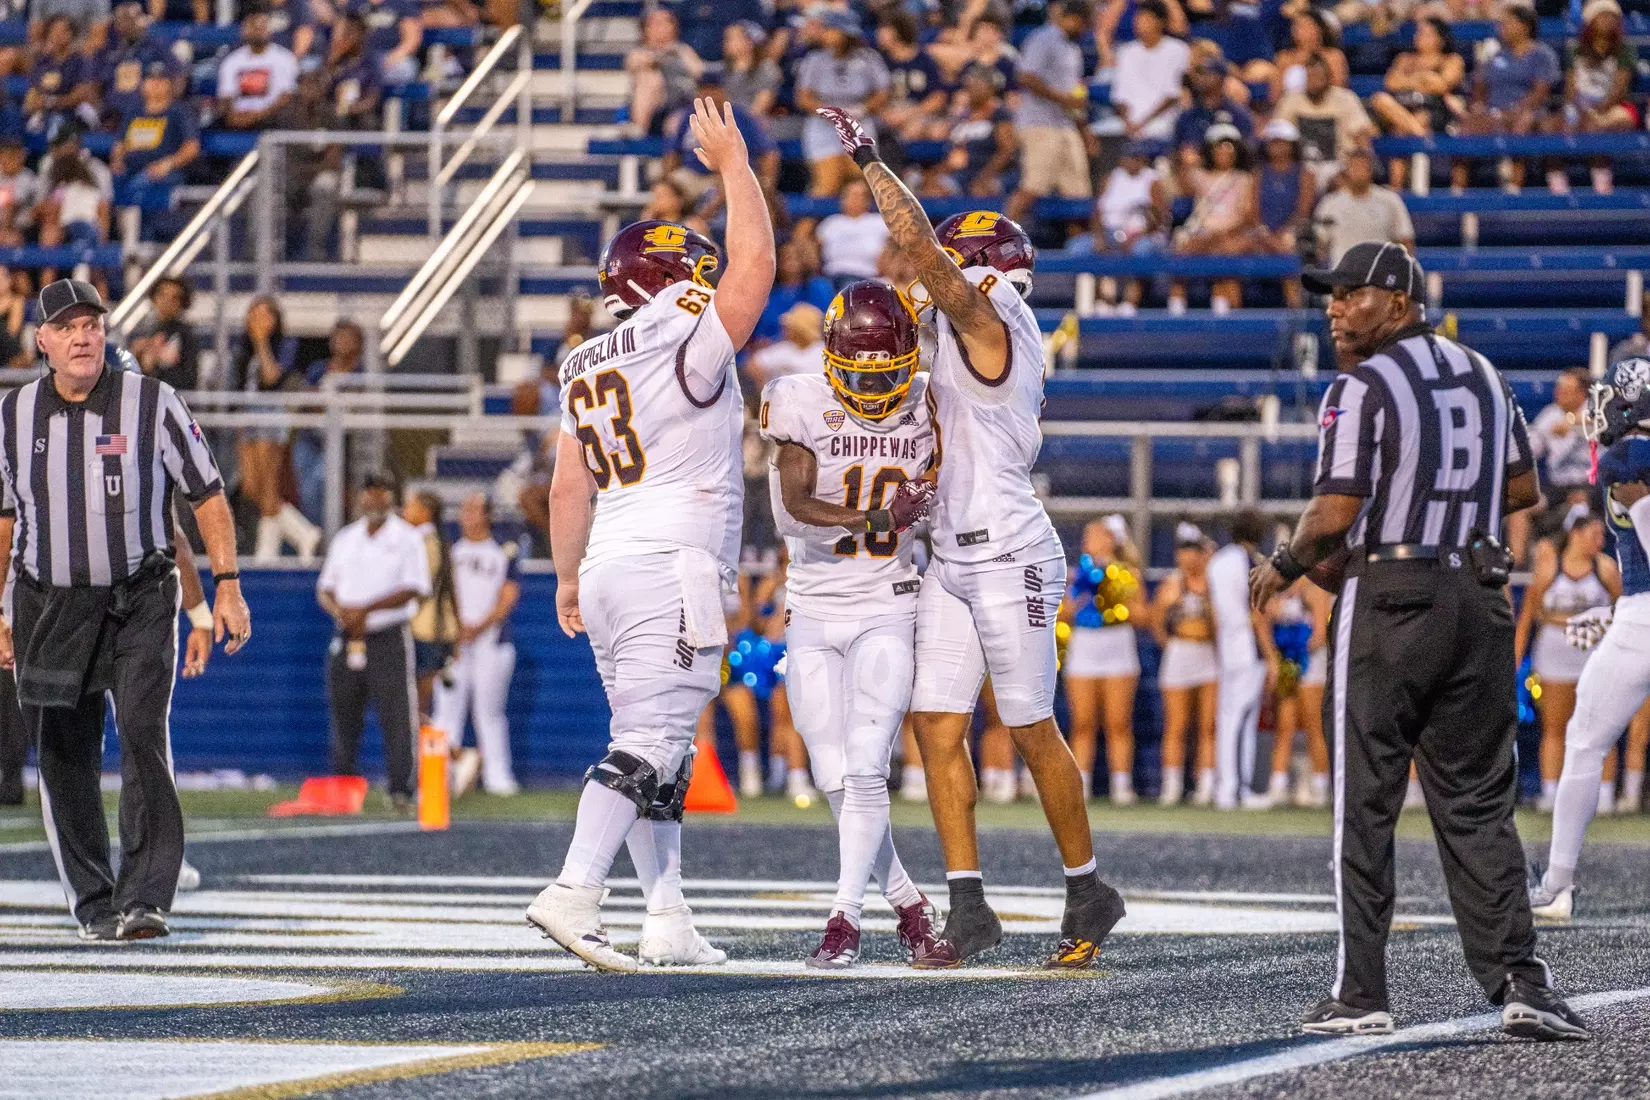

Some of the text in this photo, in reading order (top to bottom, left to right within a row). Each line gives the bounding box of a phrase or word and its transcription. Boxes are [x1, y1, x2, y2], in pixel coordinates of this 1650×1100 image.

[977, 274, 999, 296] 8
[675, 286, 712, 316] 63
[622, 326, 636, 354] III
[568, 368, 647, 490] 63
[1431, 386, 1483, 490] B
[34, 438, 46, 453] S
[831, 436, 917, 459] CHIPPEWAS
[105, 475, 121, 496] U
[834, 464, 911, 559] 10
[1448, 552, 1462, 568] S
[1024, 564, 1047, 628] FIRE UP!
